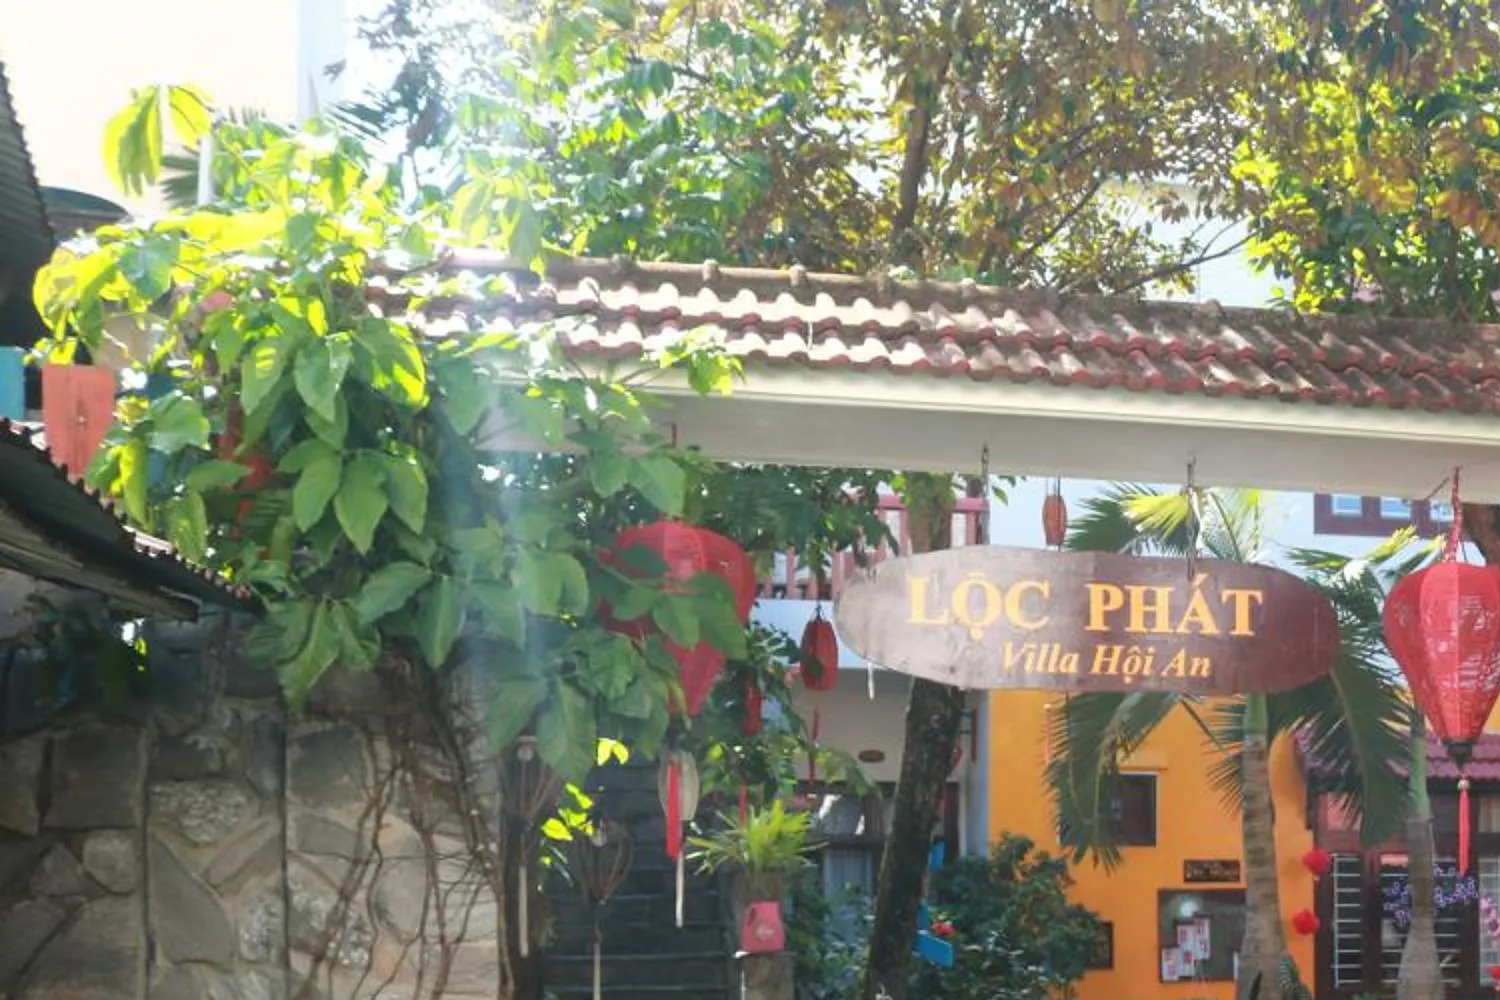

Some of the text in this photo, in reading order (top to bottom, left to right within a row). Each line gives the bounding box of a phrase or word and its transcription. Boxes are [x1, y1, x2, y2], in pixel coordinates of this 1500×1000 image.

[906, 572, 1263, 640] LỘC PHÁT
[1001, 641, 1212, 683] Villa Hội An
